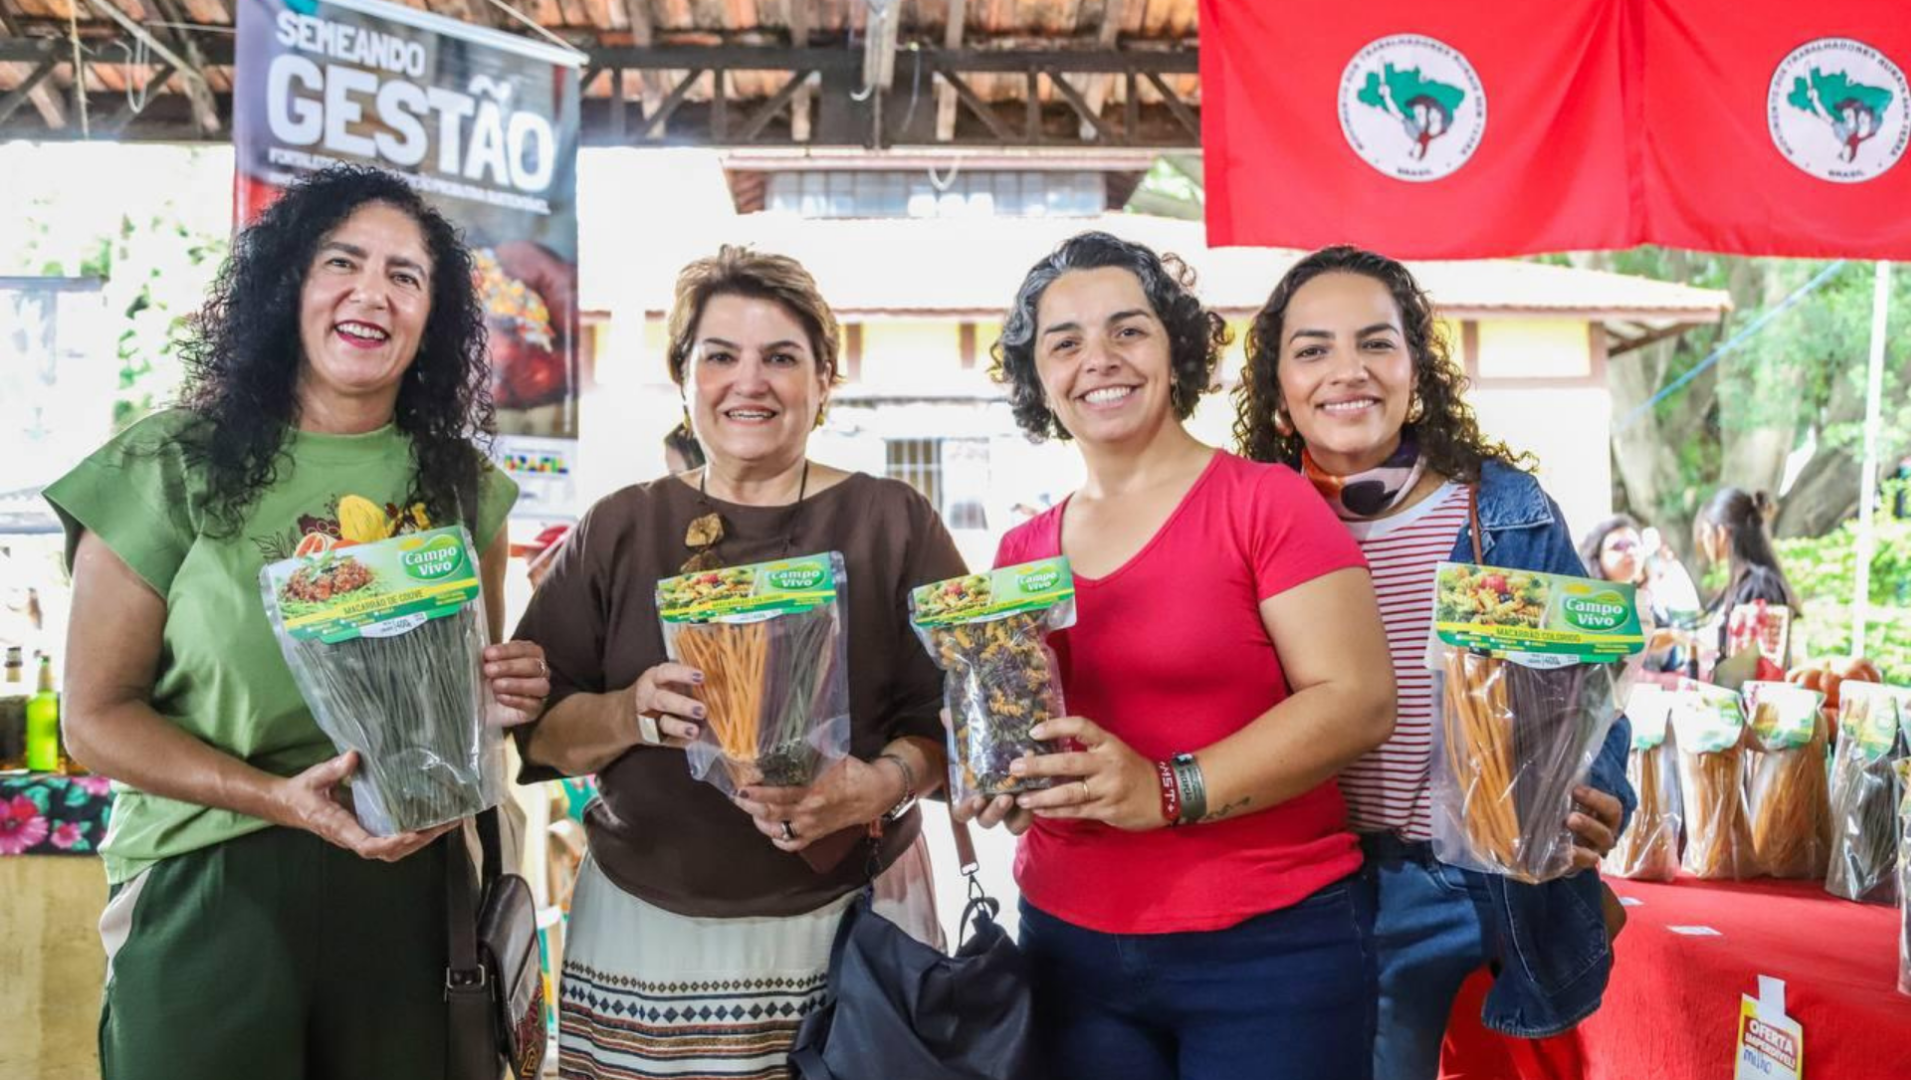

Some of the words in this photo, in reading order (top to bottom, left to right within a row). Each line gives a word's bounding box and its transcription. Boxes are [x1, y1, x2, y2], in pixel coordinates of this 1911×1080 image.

[276, 11, 426, 78] SEMEANDO
[267, 53, 556, 192] GESTÃO
[405, 546, 457, 566] Campo
[418, 560, 452, 577] Vivo
[771, 569, 820, 581] Campo
[781, 578, 813, 588] Vivo
[1565, 597, 1624, 616] Campo
[1577, 612, 1615, 627] Vivo
[1749, 1019, 1793, 1055] OFERTA
